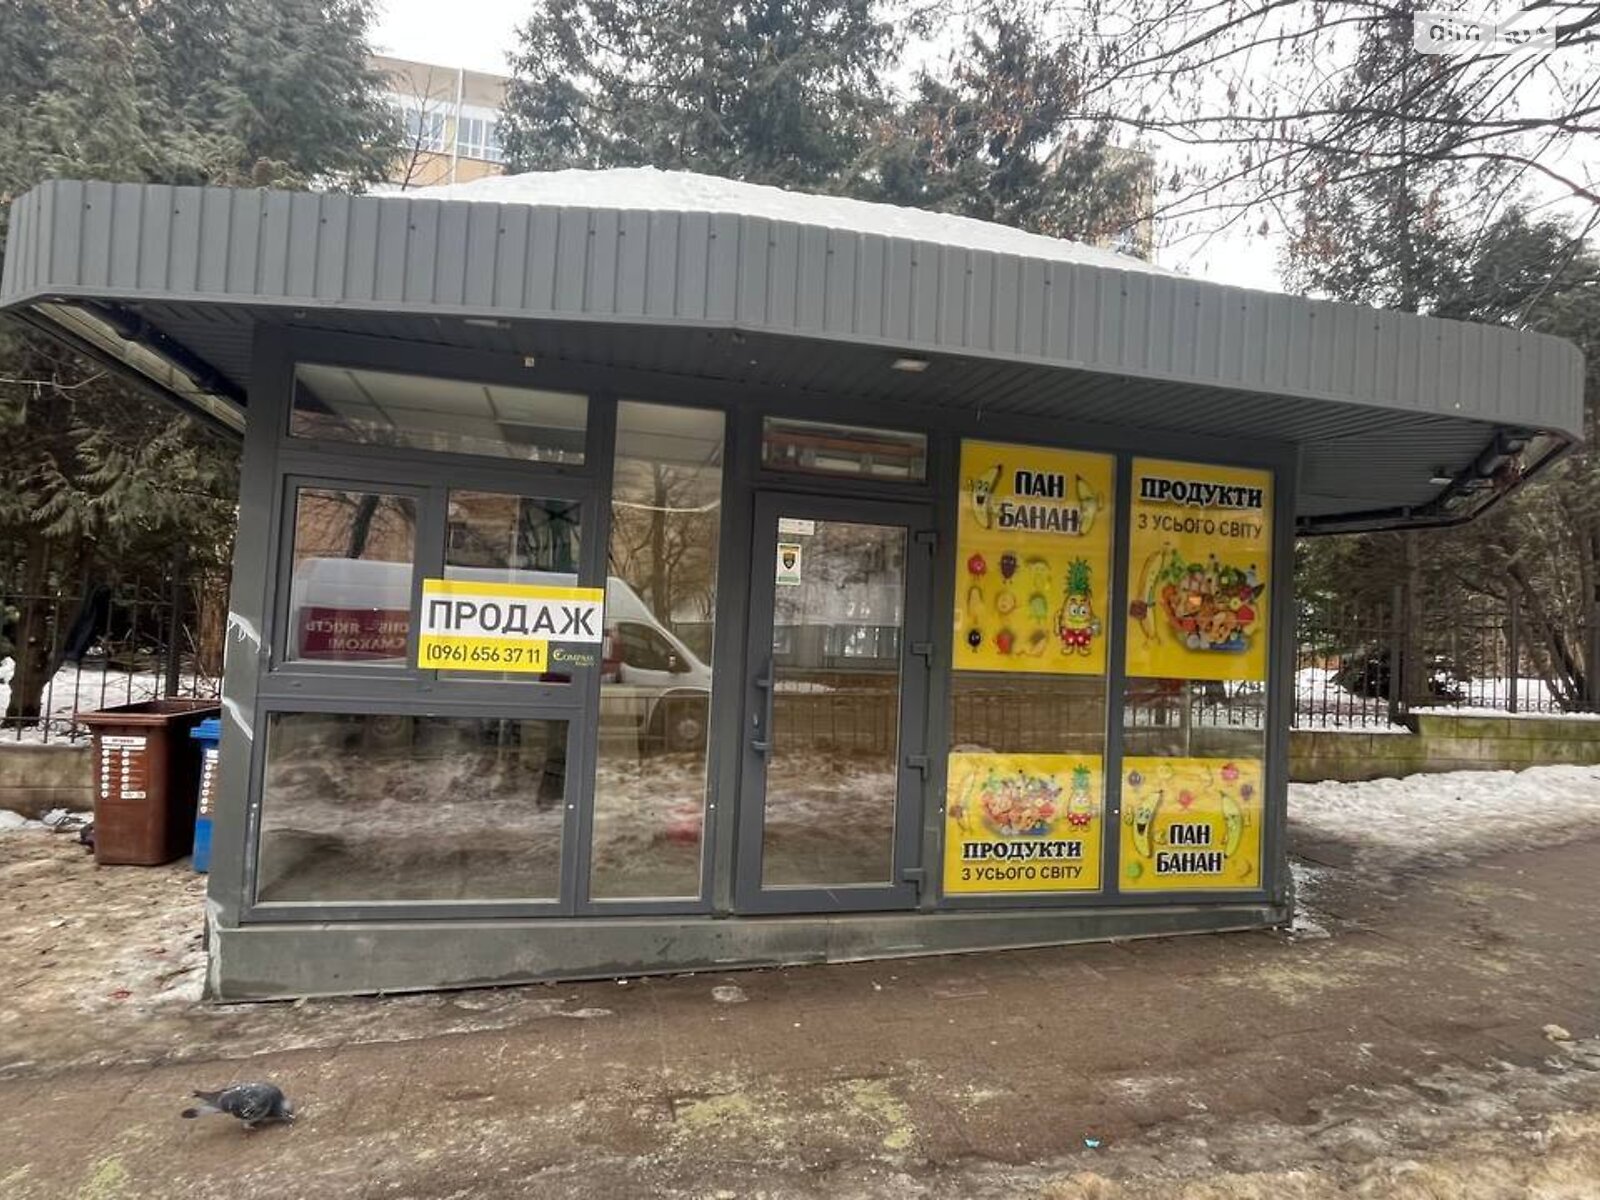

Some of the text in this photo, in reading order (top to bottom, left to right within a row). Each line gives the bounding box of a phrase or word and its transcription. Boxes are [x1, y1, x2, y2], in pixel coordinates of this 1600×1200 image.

[1014, 471, 1064, 498] ПАН
[1140, 477, 1263, 508] ПРОДУКТИ
[999, 503, 1080, 532] БАНАН
[1138, 513, 1262, 539] З УСЬОГО СВІТУ
[428, 600, 594, 635] ПРОДАЖ
[426, 643, 540, 663] (096) 656 37 11
[1169, 825, 1210, 844] ПАН
[963, 841, 1081, 859] ПРОДУКТИ
[961, 866, 1082, 881] З УСЬОГО СВІТУ
[1156, 852, 1221, 872] БАНАН
